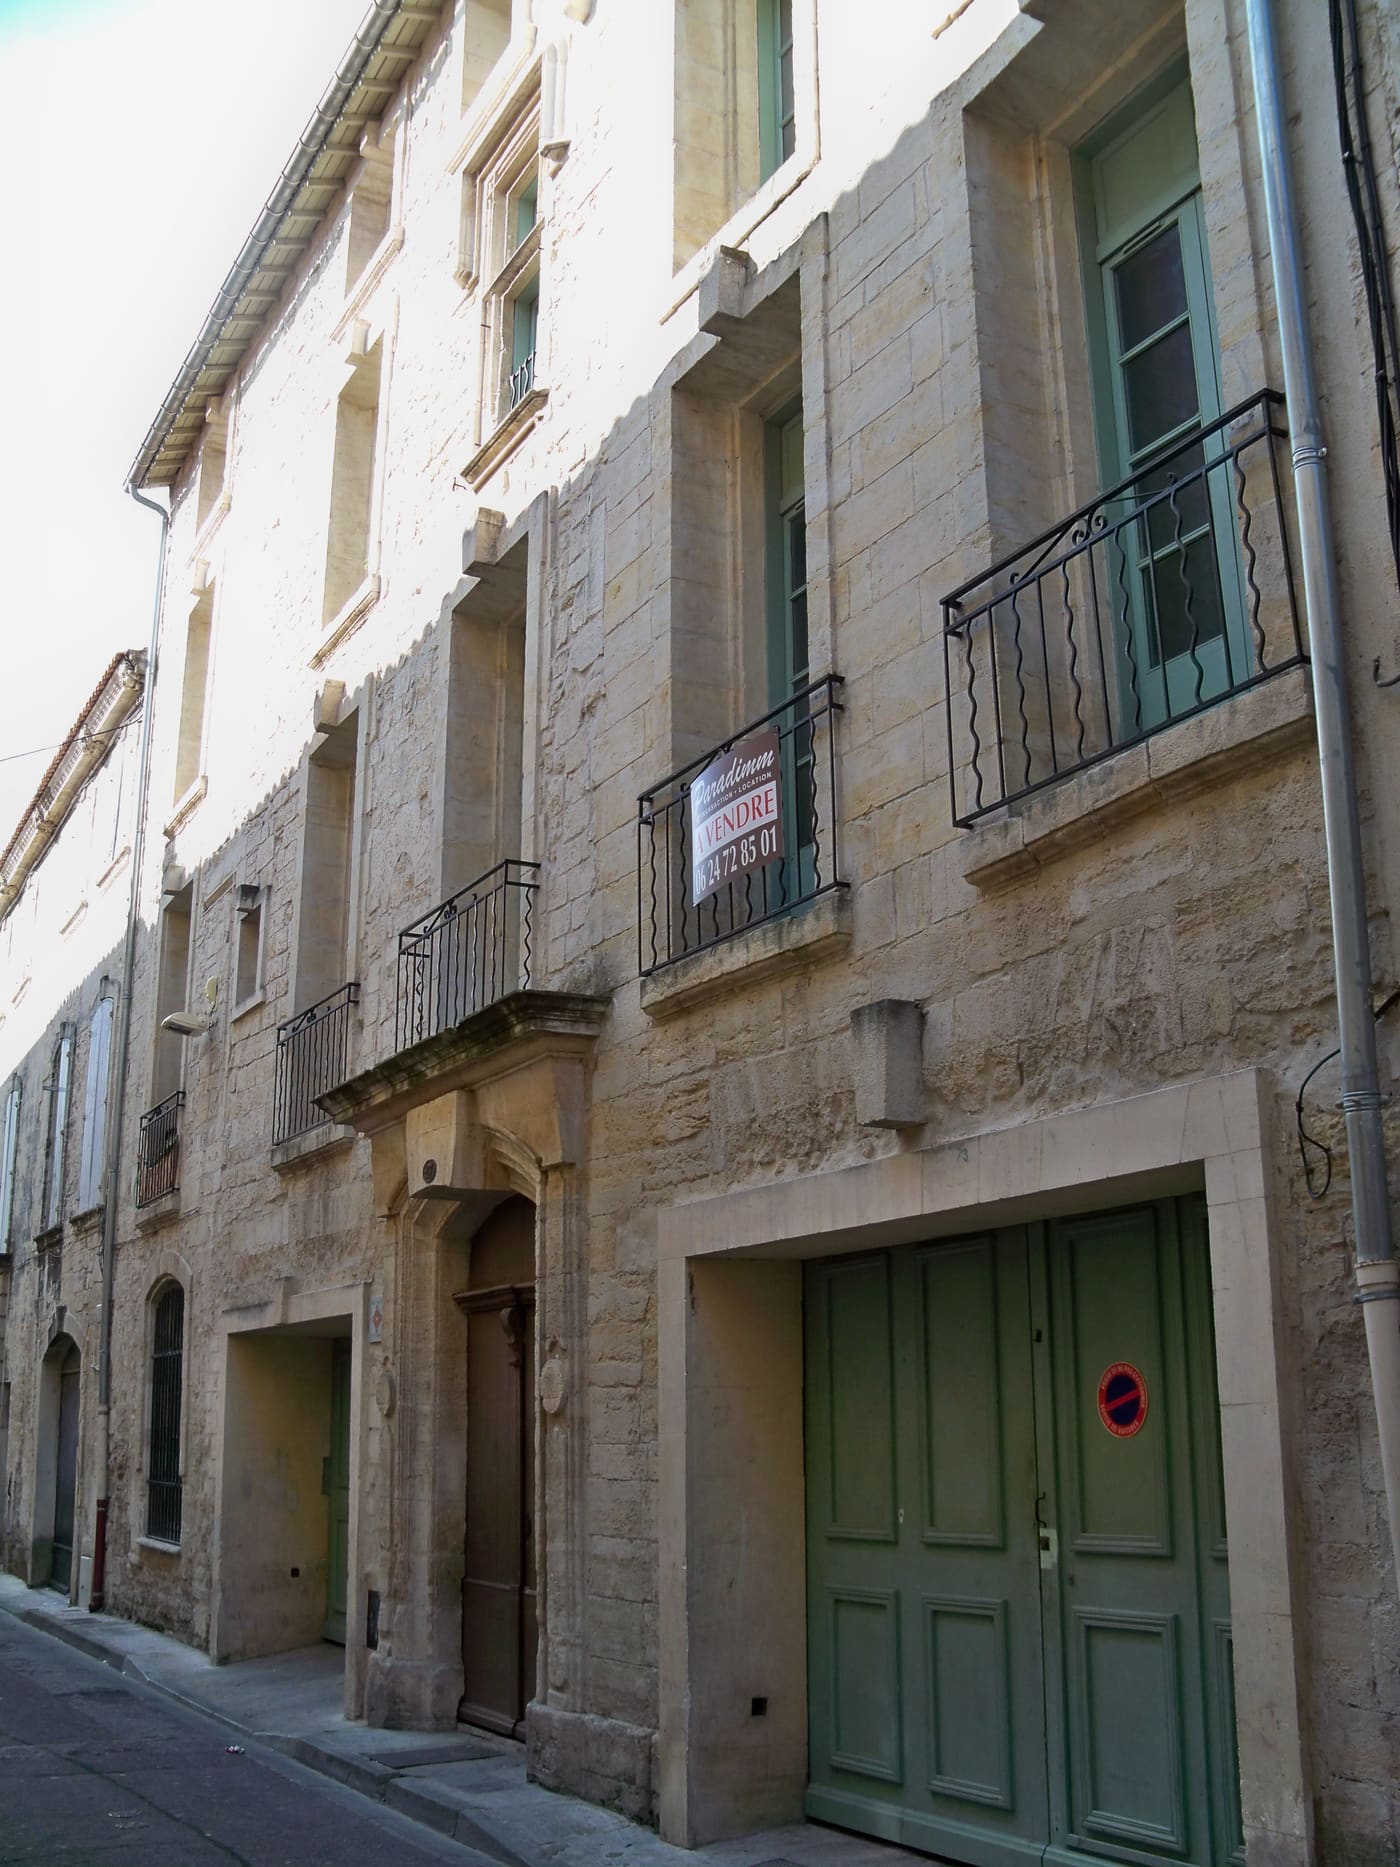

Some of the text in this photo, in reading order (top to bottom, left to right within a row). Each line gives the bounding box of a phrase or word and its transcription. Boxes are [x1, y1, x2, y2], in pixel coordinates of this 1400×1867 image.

[694, 749, 775, 813] Paradimm
[738, 771, 772, 793] LOCATION
[705, 788, 774, 848] VENDRE
[695, 824, 777, 895] 06 24 72 85 01
